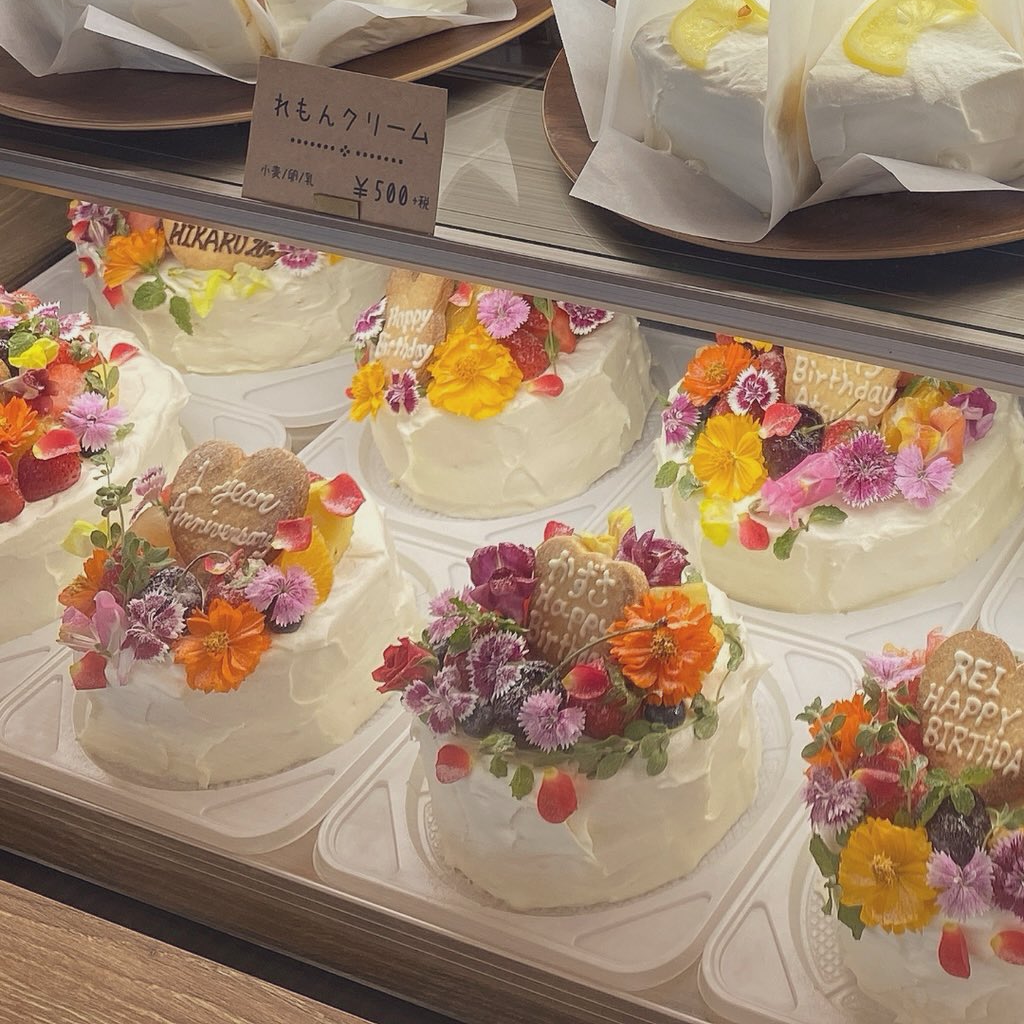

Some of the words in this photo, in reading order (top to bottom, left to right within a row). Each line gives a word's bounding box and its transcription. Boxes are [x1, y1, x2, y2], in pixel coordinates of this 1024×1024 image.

[274, 93, 428, 145] れもんクリーム
[261, 164, 314, 187] 小麦/卵/乳
[169, 222, 249, 255] HIKARU
[386, 305, 433, 334] Happy
[792, 355, 897, 416] Birthday
[210, 478, 281, 515] year
[946, 649, 1007, 696] REI
[923, 682, 1023, 736] HAPPY
